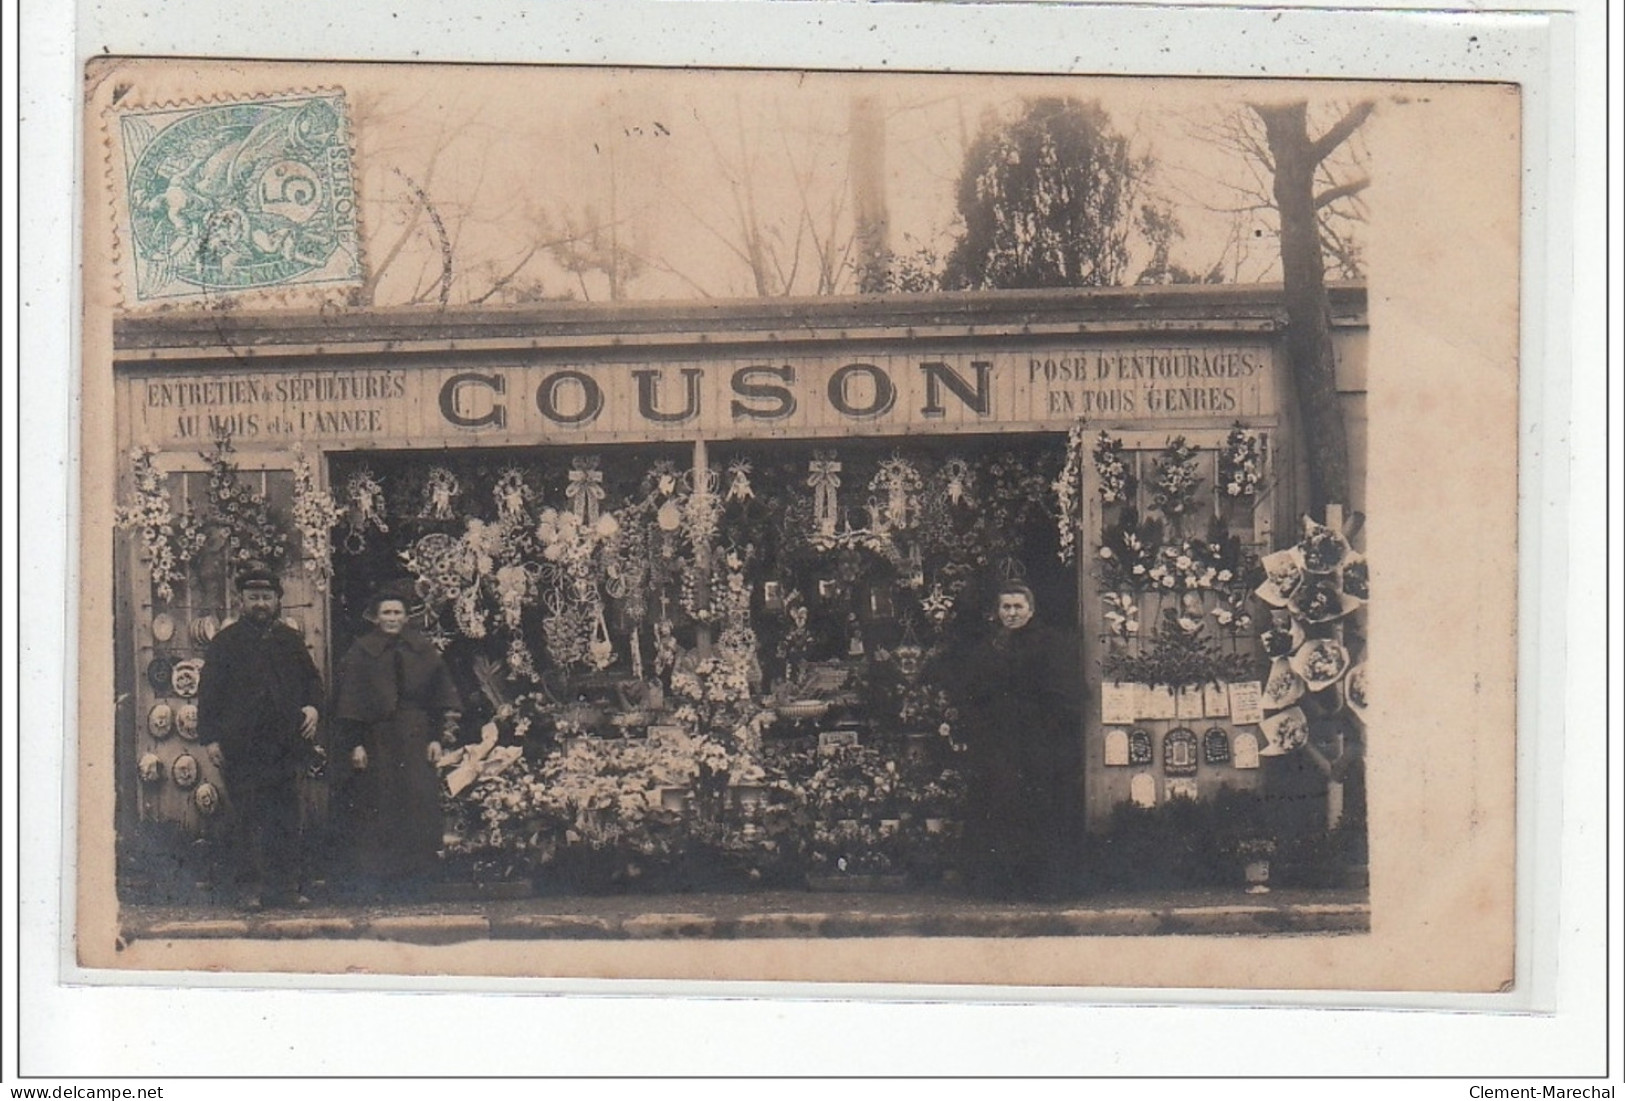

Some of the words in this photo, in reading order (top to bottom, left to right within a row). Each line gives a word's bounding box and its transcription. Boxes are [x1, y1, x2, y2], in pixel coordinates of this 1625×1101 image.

[330, 147, 354, 228] POSTES
[1028, 356, 1088, 383] POSE
[1096, 353, 1255, 381] D'ENTOURAGES
[148, 379, 260, 407] ENTRETIEN
[438, 361, 993, 429] COUSON
[1048, 389, 1075, 413] EN
[1082, 389, 1135, 413] TOUS
[1146, 387, 1237, 412] GENRES
[173, 415, 199, 438] AU
